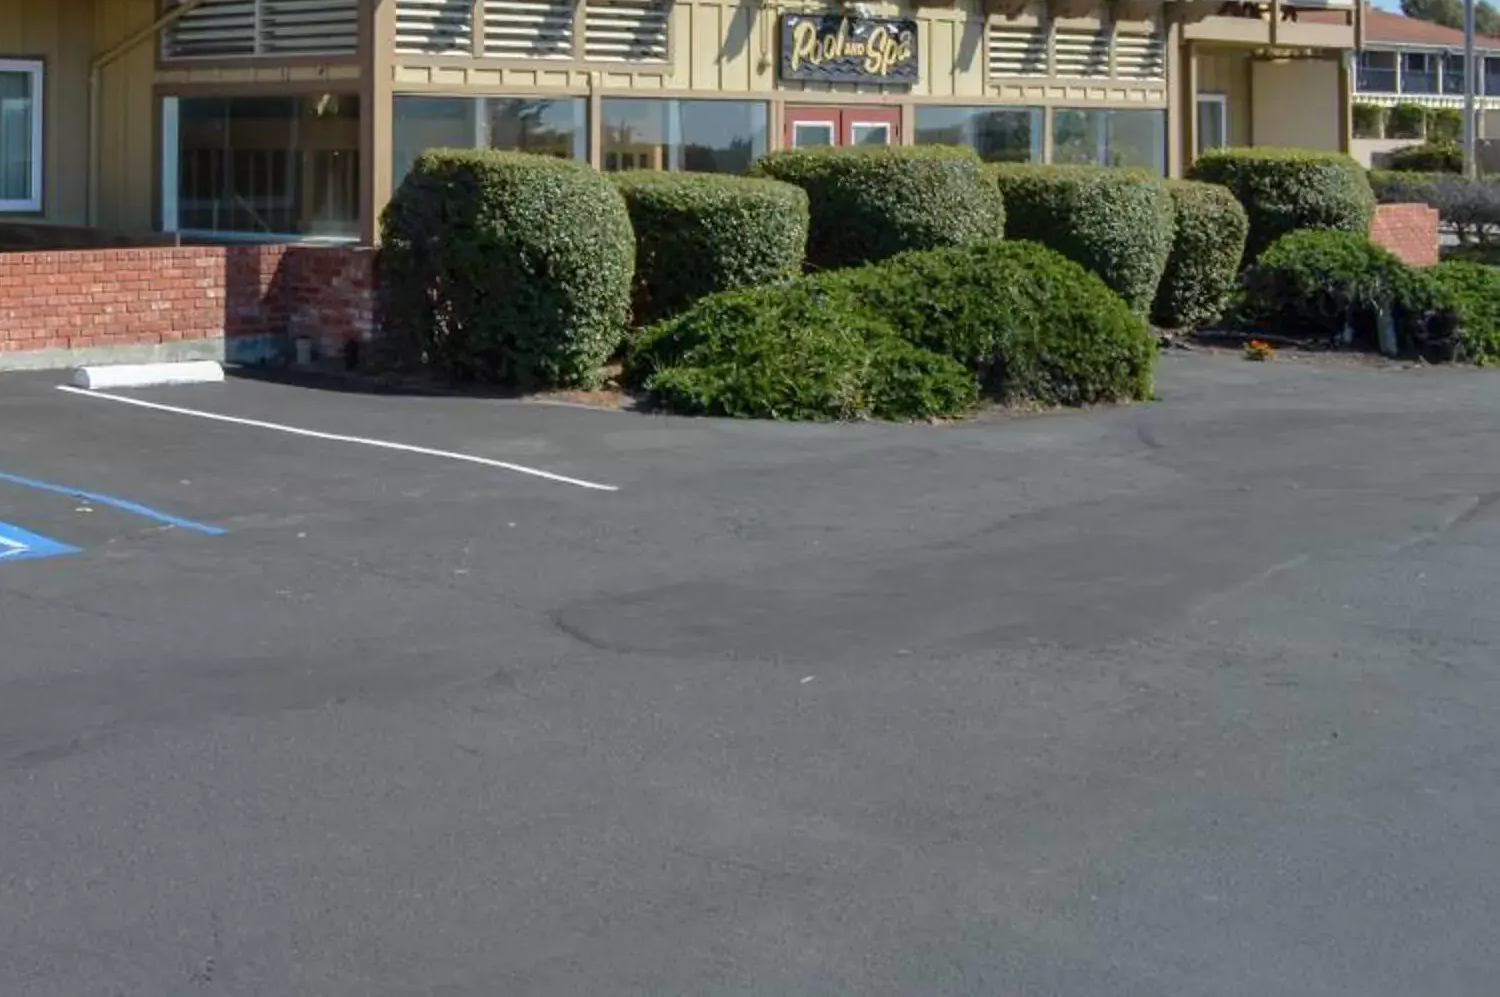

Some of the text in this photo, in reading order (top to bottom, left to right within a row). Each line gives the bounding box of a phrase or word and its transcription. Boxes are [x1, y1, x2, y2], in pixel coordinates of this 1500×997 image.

[792, 16, 912, 76] Pool AND Spa
